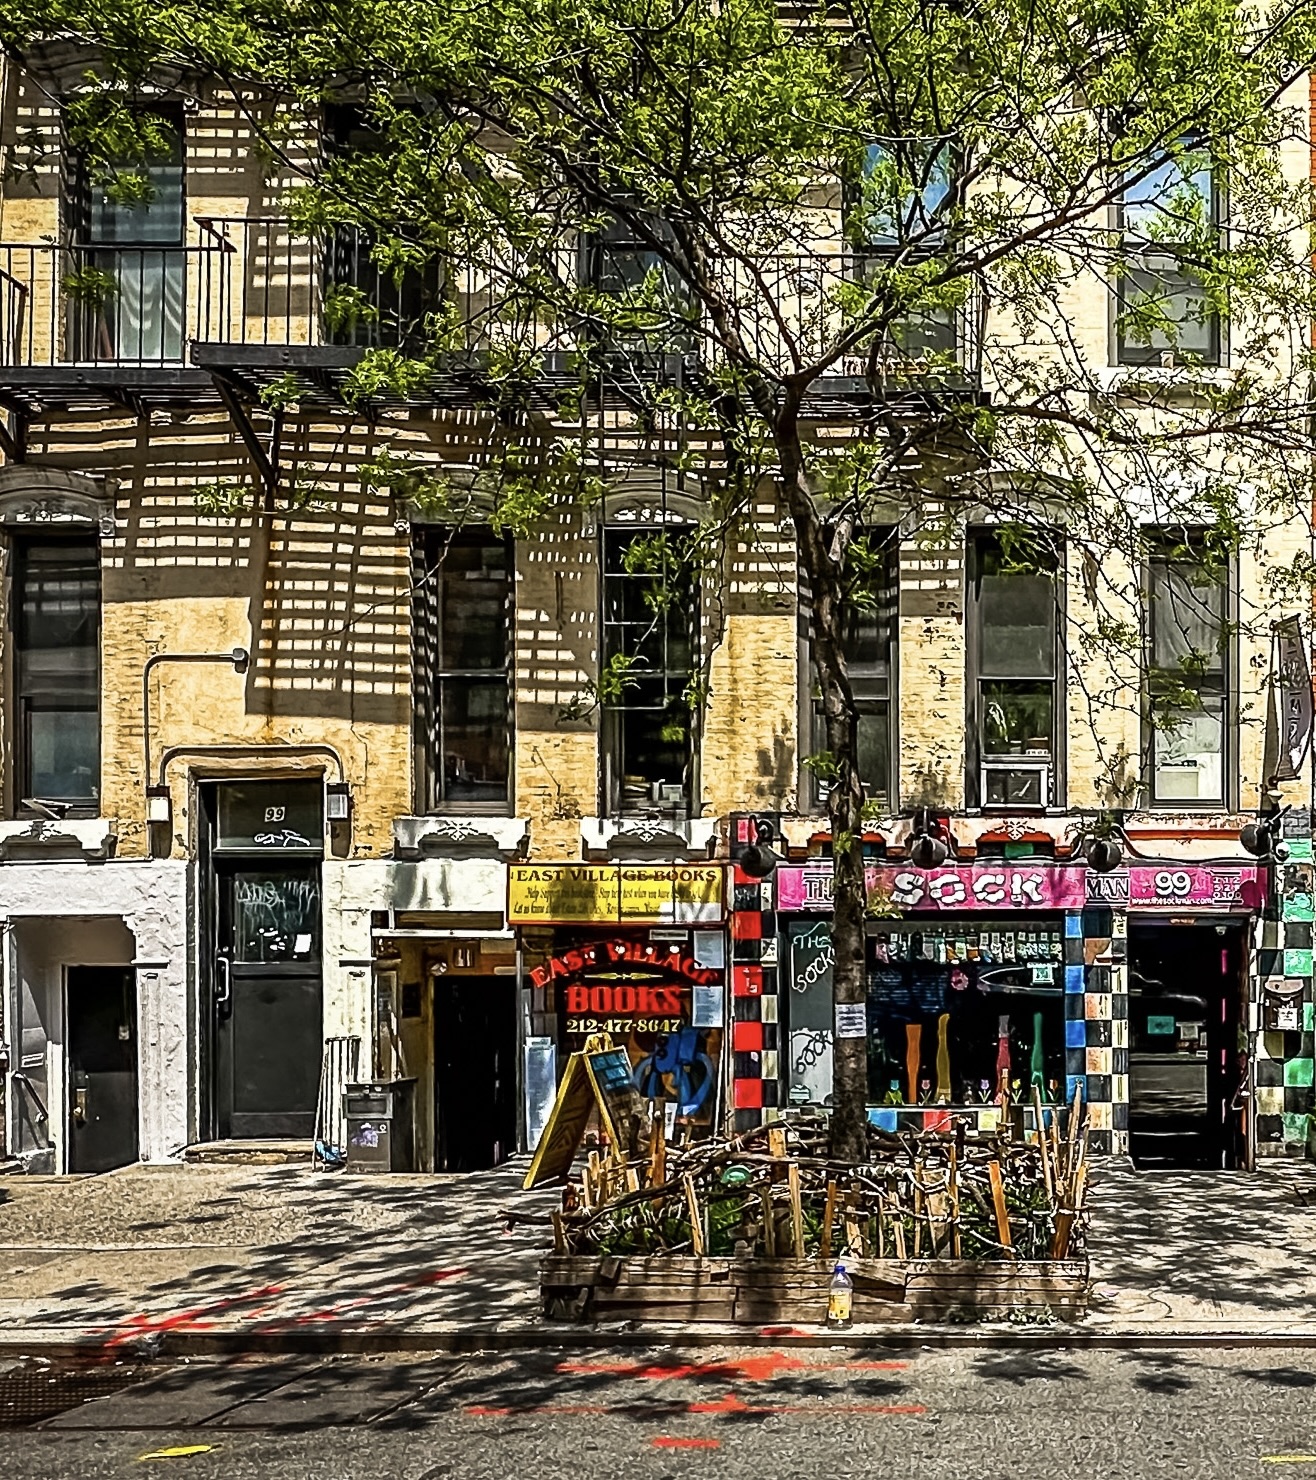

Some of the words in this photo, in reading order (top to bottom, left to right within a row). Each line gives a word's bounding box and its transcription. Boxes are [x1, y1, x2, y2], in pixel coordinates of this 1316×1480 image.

[266, 808, 284, 821] 99
[516, 870, 564, 881] EAST
[570, 870, 648, 881] VILLAGE
[653, 870, 717, 881] BOOKS
[1154, 871, 1192, 896] 99
[803, 878, 834, 899] TH
[890, 872, 1044, 905] SOCK
[1085, 877, 1131, 898] MAN
[529, 946, 597, 988] EAST
[605, 939, 719, 984] VILLAGE
[566, 986, 682, 1014] BOOKS
[566, 1018, 681, 1034] 212-477-8647
